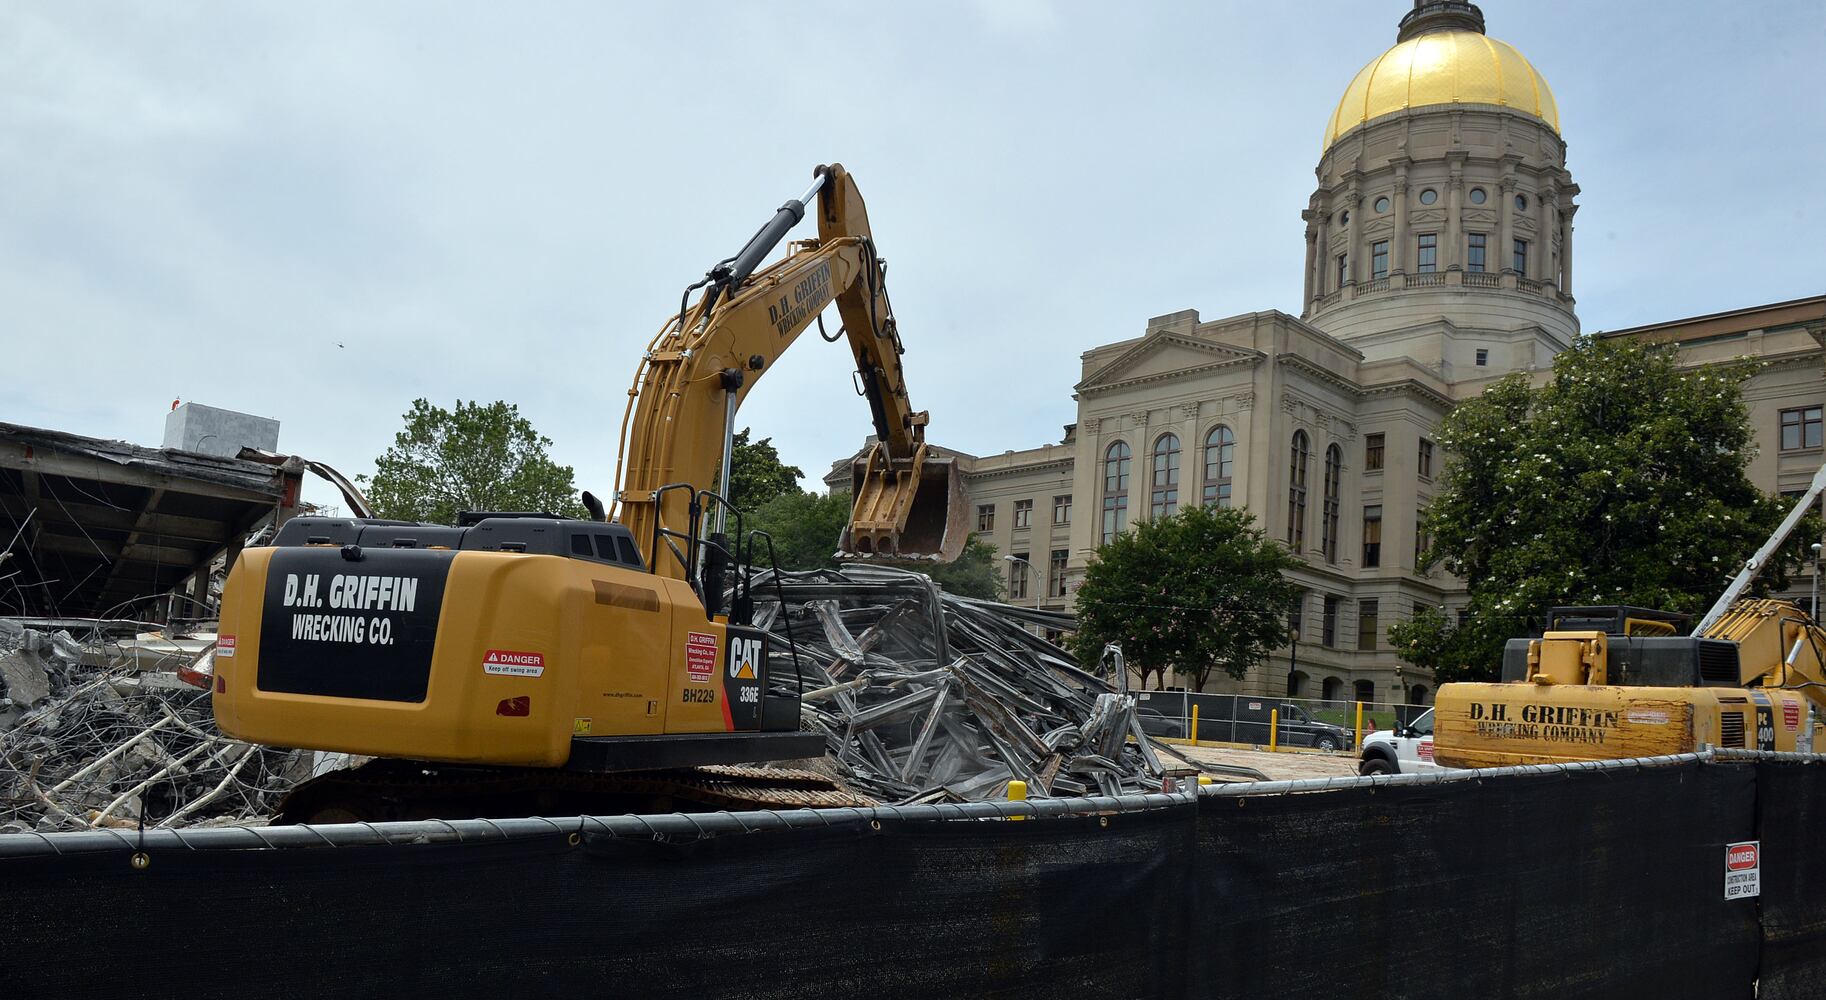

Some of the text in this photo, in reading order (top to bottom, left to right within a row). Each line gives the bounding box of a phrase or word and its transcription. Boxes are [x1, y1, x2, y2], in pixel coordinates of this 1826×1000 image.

[768, 261, 831, 326] D.H. GRIFFIN
[777, 282, 830, 338] WRECKING COMPANY
[283, 574, 419, 612] D.H. GRIFFIN
[292, 614, 394, 645] WRECKING CO.
[699, 636, 715, 645] GRIFFIN
[501, 654, 541, 665] DANGER
[730, 637, 762, 679] CAT
[489, 665, 501, 673] Keep
[682, 688, 715, 703] BH229
[740, 686, 759, 703] 336E
[1470, 702, 1620, 728] D.H. GRIFFIN
[1757, 712, 1768, 726] PC
[1478, 721, 1607, 744] WRECKING COMPANY
[1758, 727, 1774, 742] 400
[1730, 852, 1755, 864] DANGER
[1728, 884, 1756, 896] KEEP OUT
